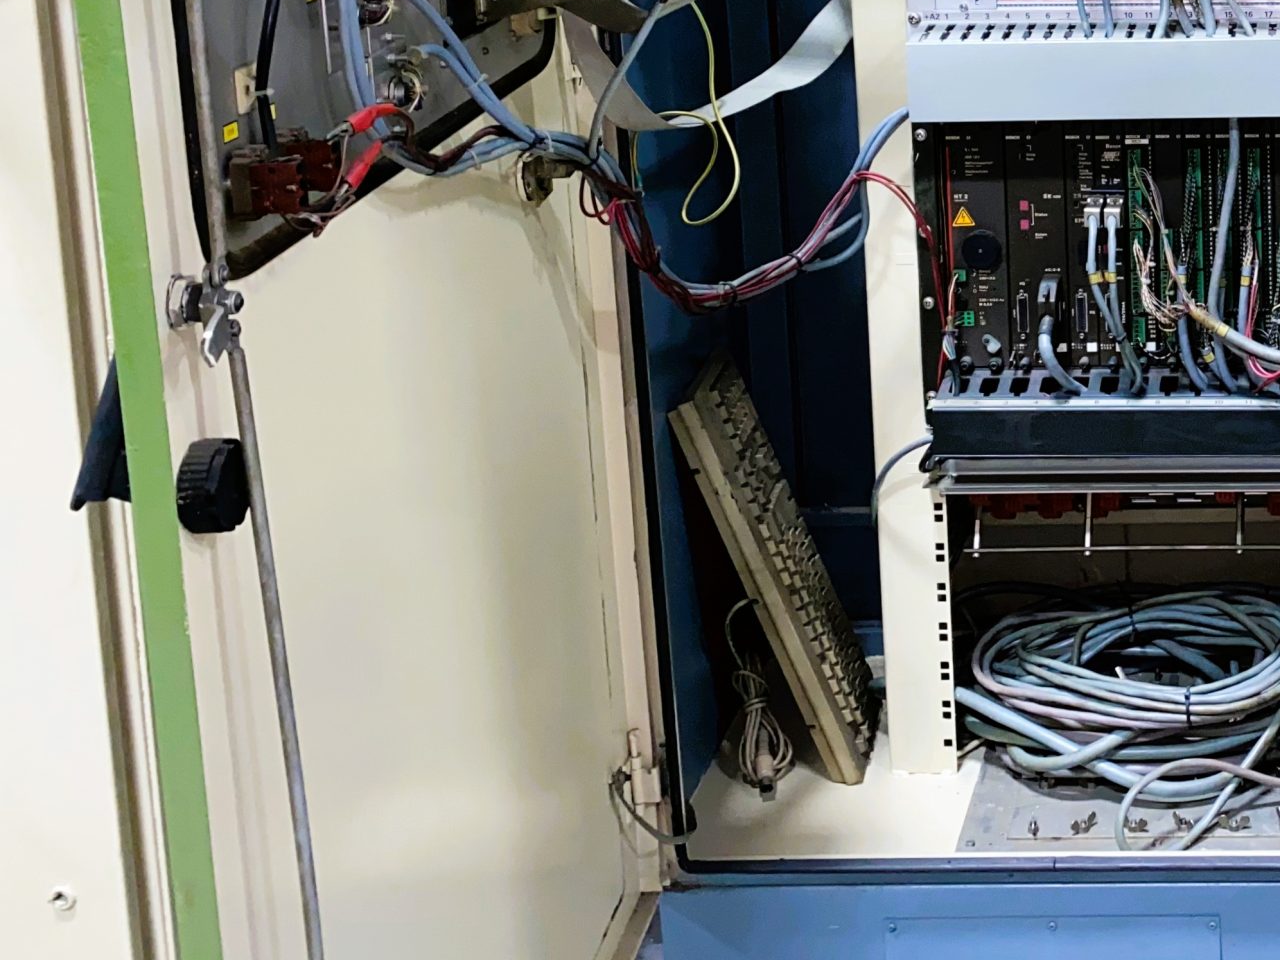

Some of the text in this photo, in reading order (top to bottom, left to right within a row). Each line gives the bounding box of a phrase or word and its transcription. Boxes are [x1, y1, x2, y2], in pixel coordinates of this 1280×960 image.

[1005, 12, 1010, 20] 4
[1025, 12, 1030, 20] 5
[1045, 12, 1050, 20] 6
[1065, 12, 1070, 20] 7
